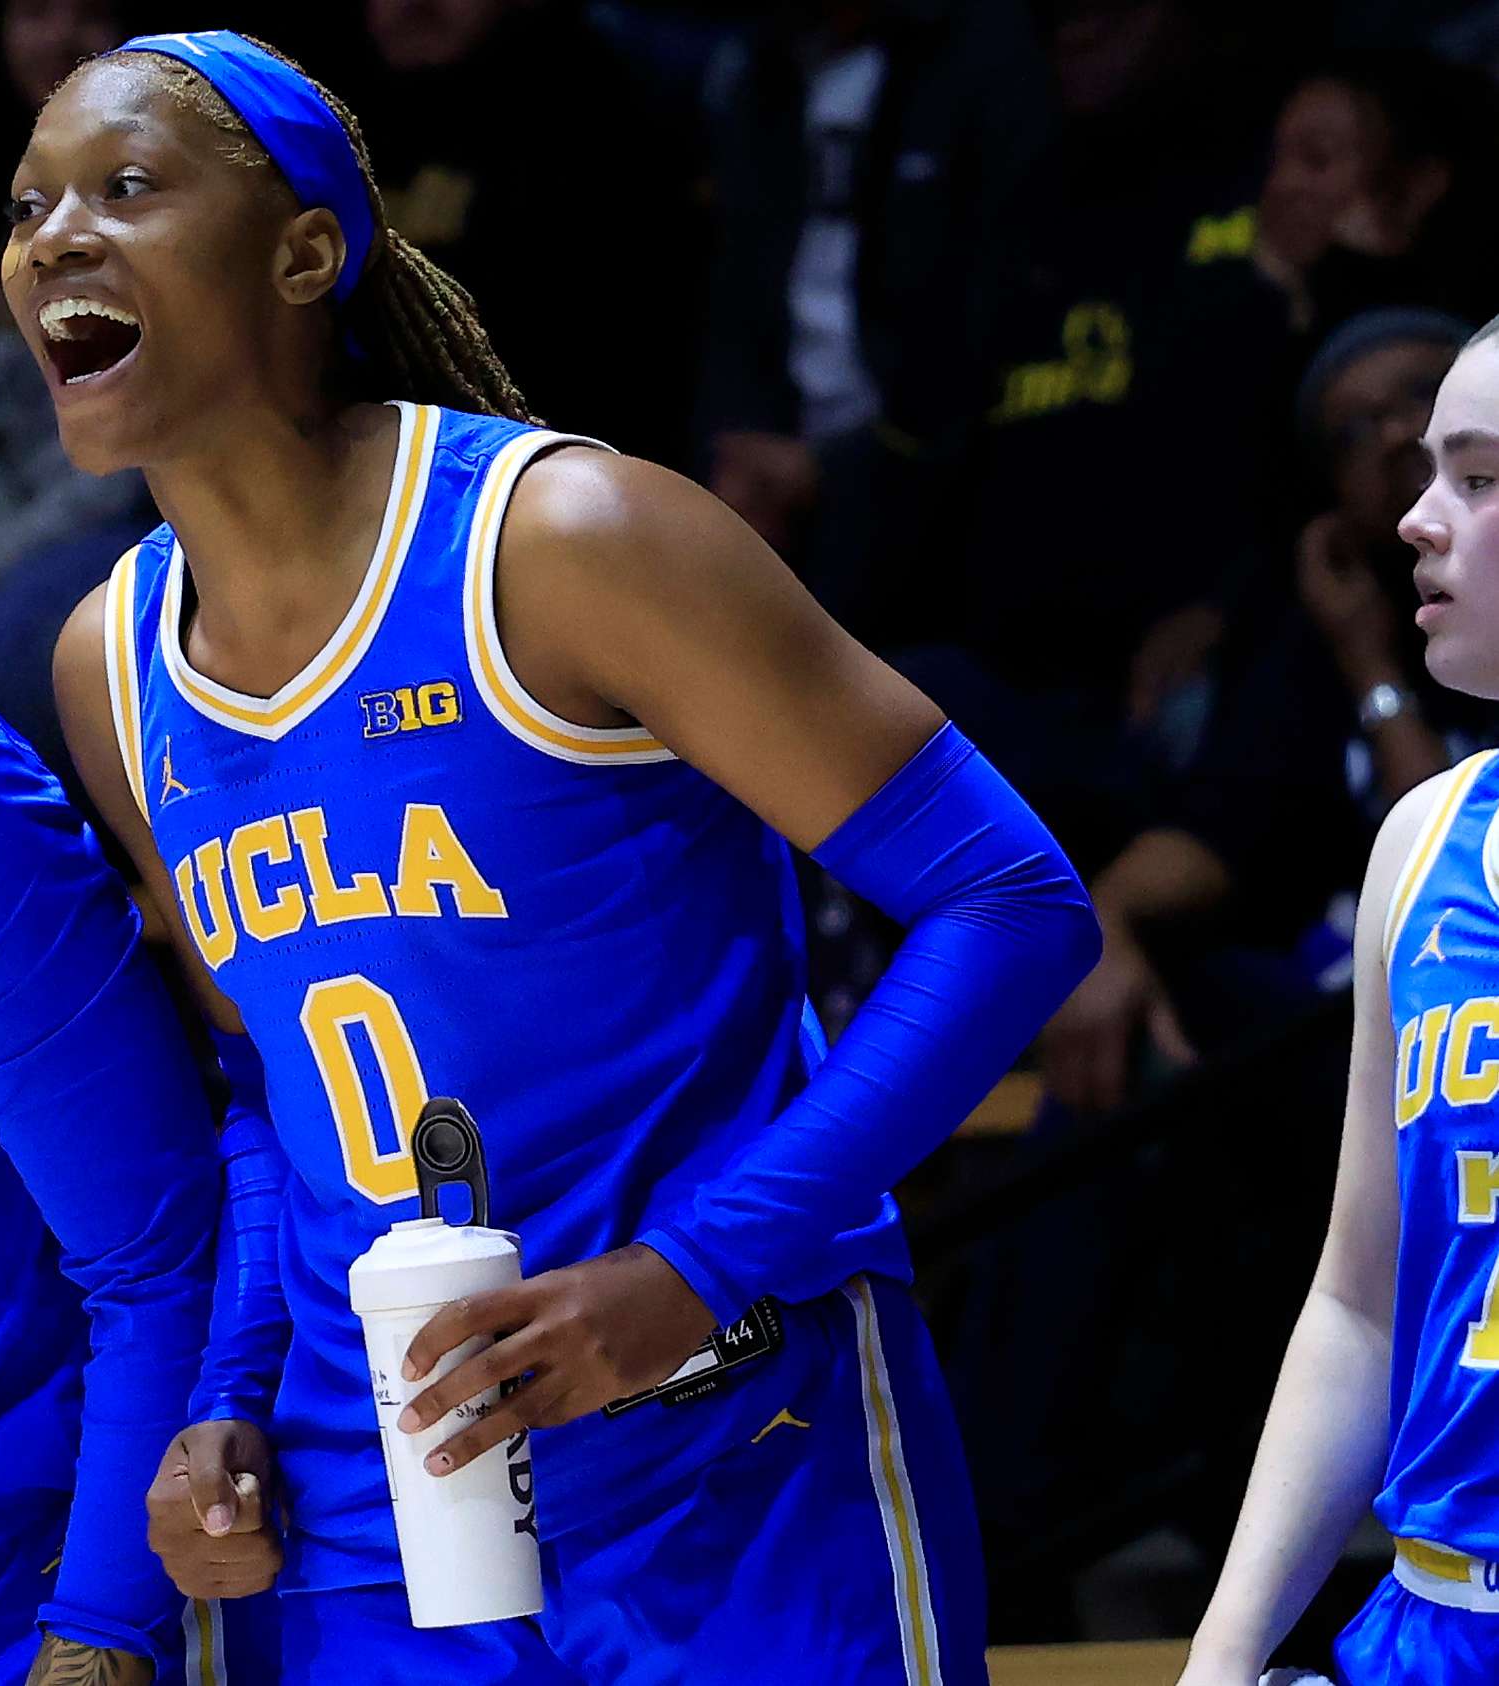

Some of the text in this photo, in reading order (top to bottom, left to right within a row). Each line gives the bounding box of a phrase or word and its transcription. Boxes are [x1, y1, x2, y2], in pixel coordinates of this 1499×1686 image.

[174, 803, 509, 970] UCLA
[299, 974, 430, 1205] 0
[724, 1319, 754, 1346] 44
